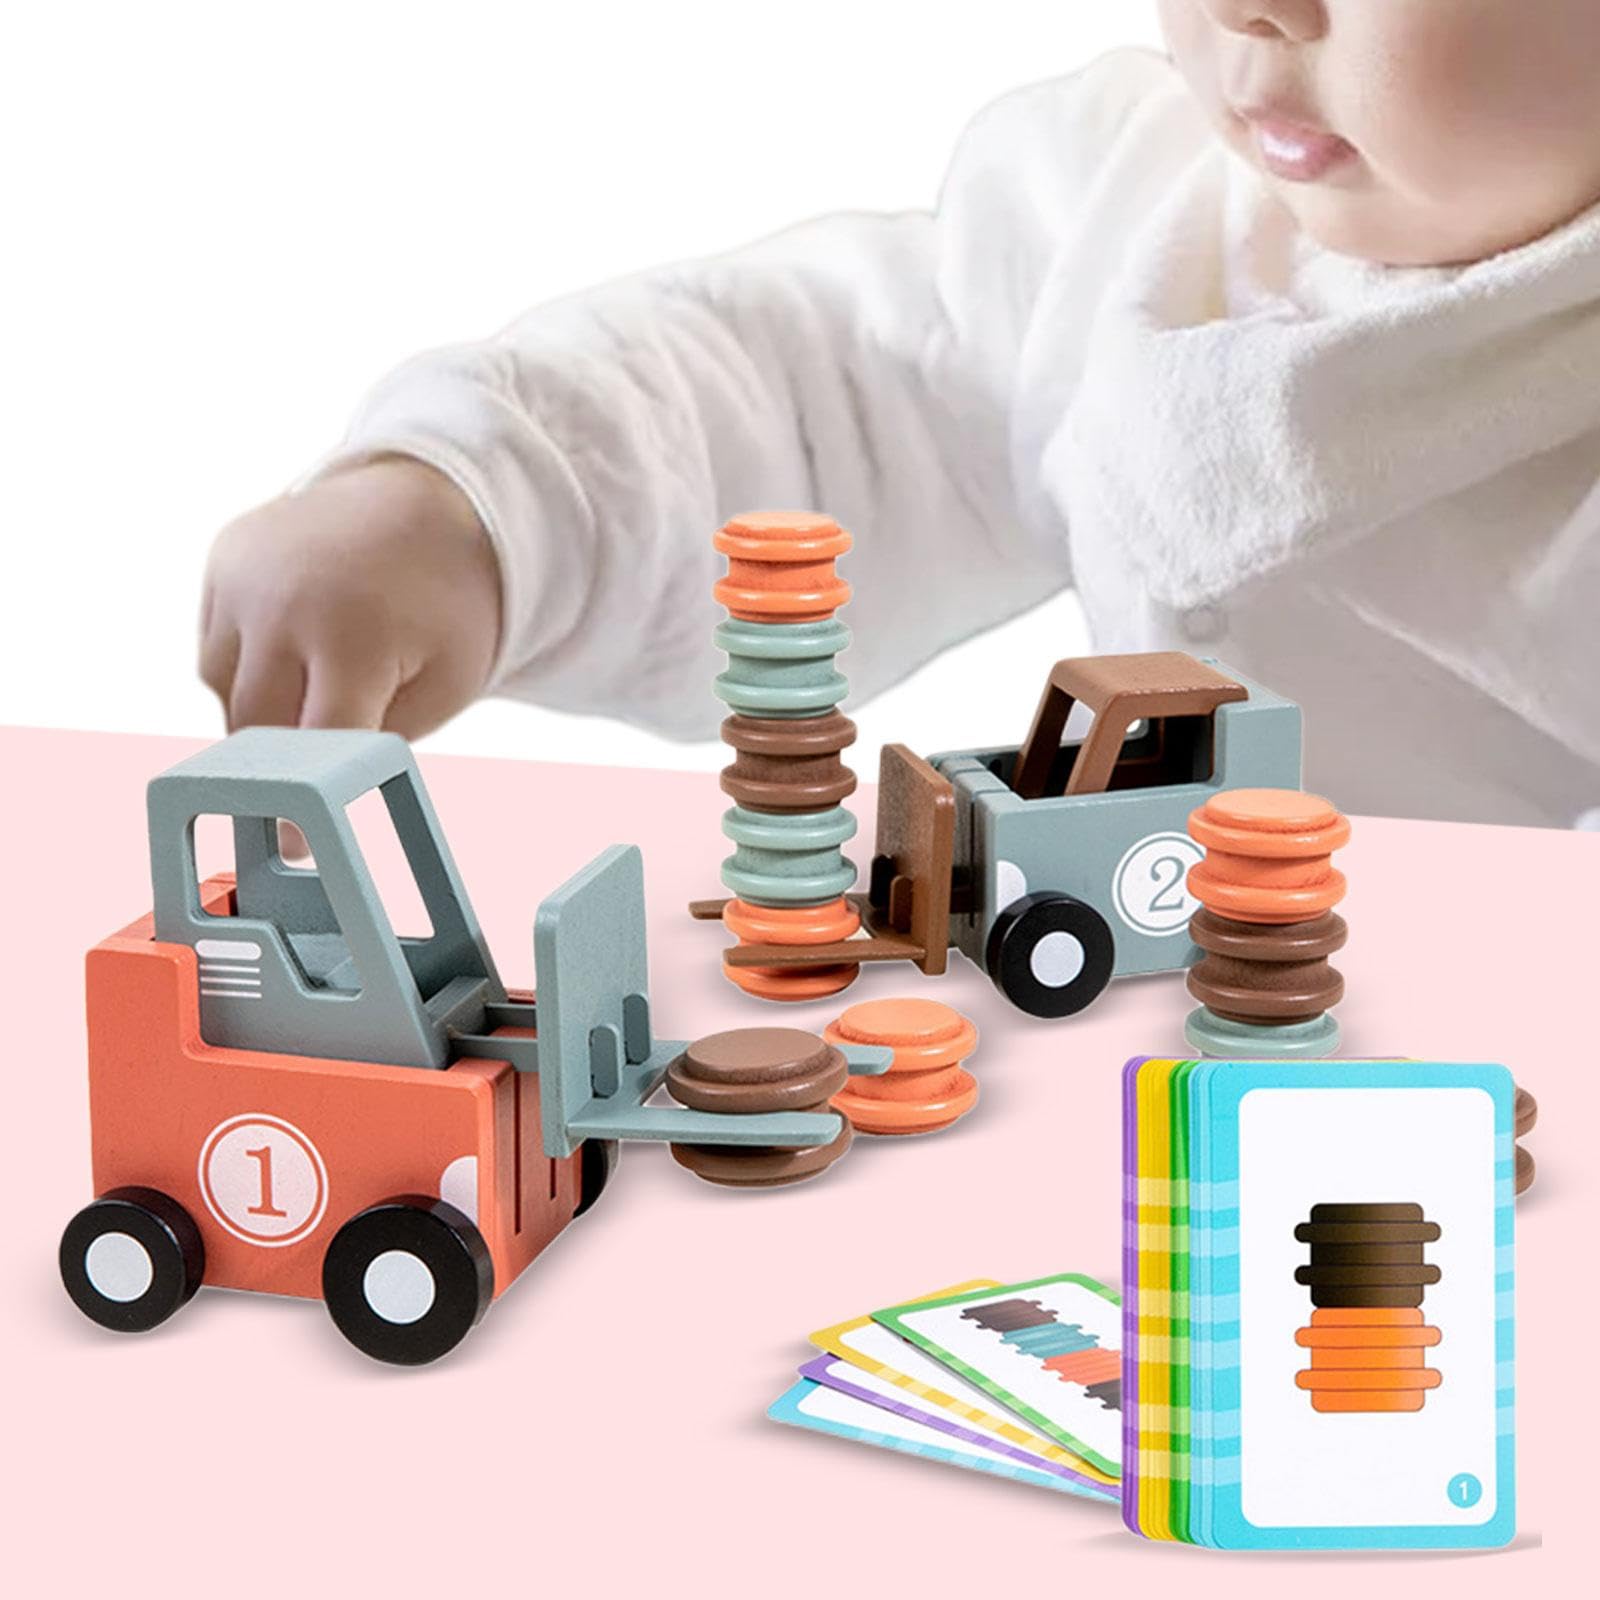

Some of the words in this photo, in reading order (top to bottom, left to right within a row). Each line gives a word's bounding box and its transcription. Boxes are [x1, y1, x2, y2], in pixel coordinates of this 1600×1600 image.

[1149, 855, 1186, 913] 2
[245, 1146, 287, 1217] 1
[1459, 1481, 1469, 1501] 1
